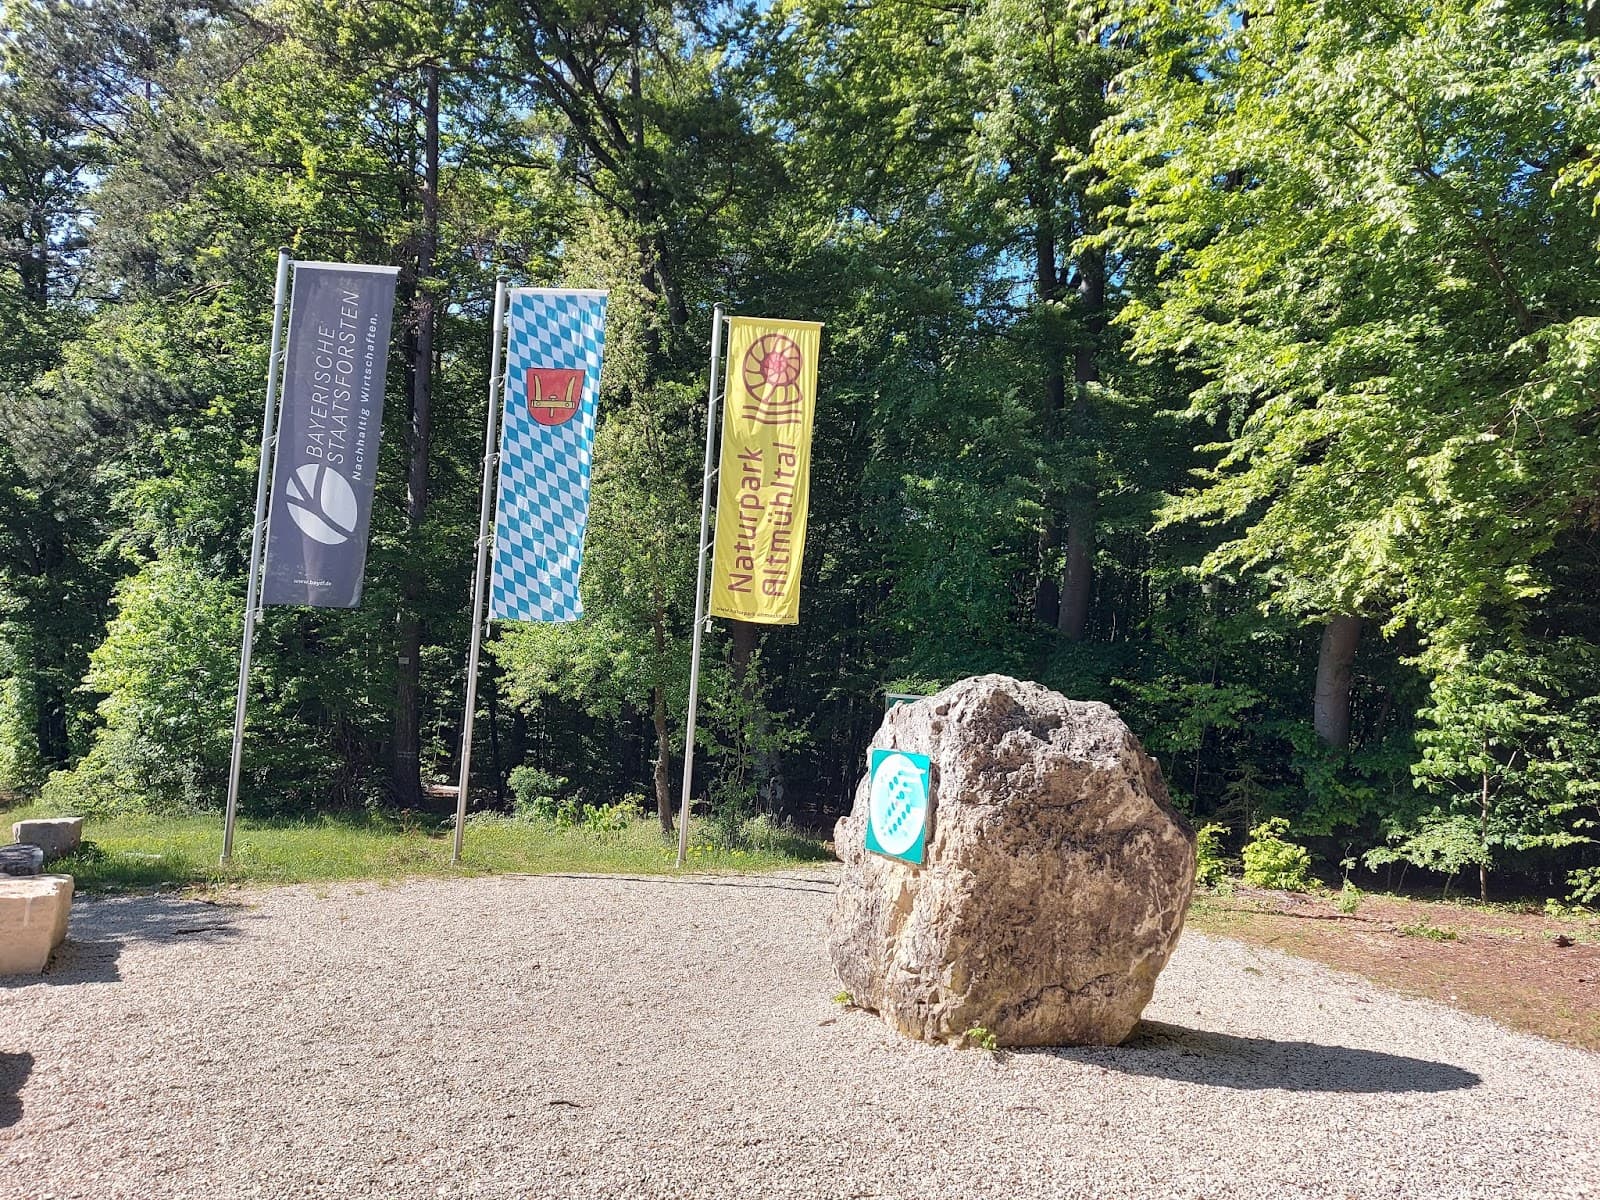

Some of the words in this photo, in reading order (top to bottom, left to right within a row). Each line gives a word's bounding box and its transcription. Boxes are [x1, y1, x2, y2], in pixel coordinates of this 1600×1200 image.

[305, 324, 336, 458] BAYERISCHE
[326, 290, 361, 465] STAATSFORSTEN
[360, 313, 378, 402] Wirtschaften.
[352, 407, 370, 481] Nachhaltig
[727, 446, 765, 593] Naturpark
[761, 442, 797, 597] Altmühltal
